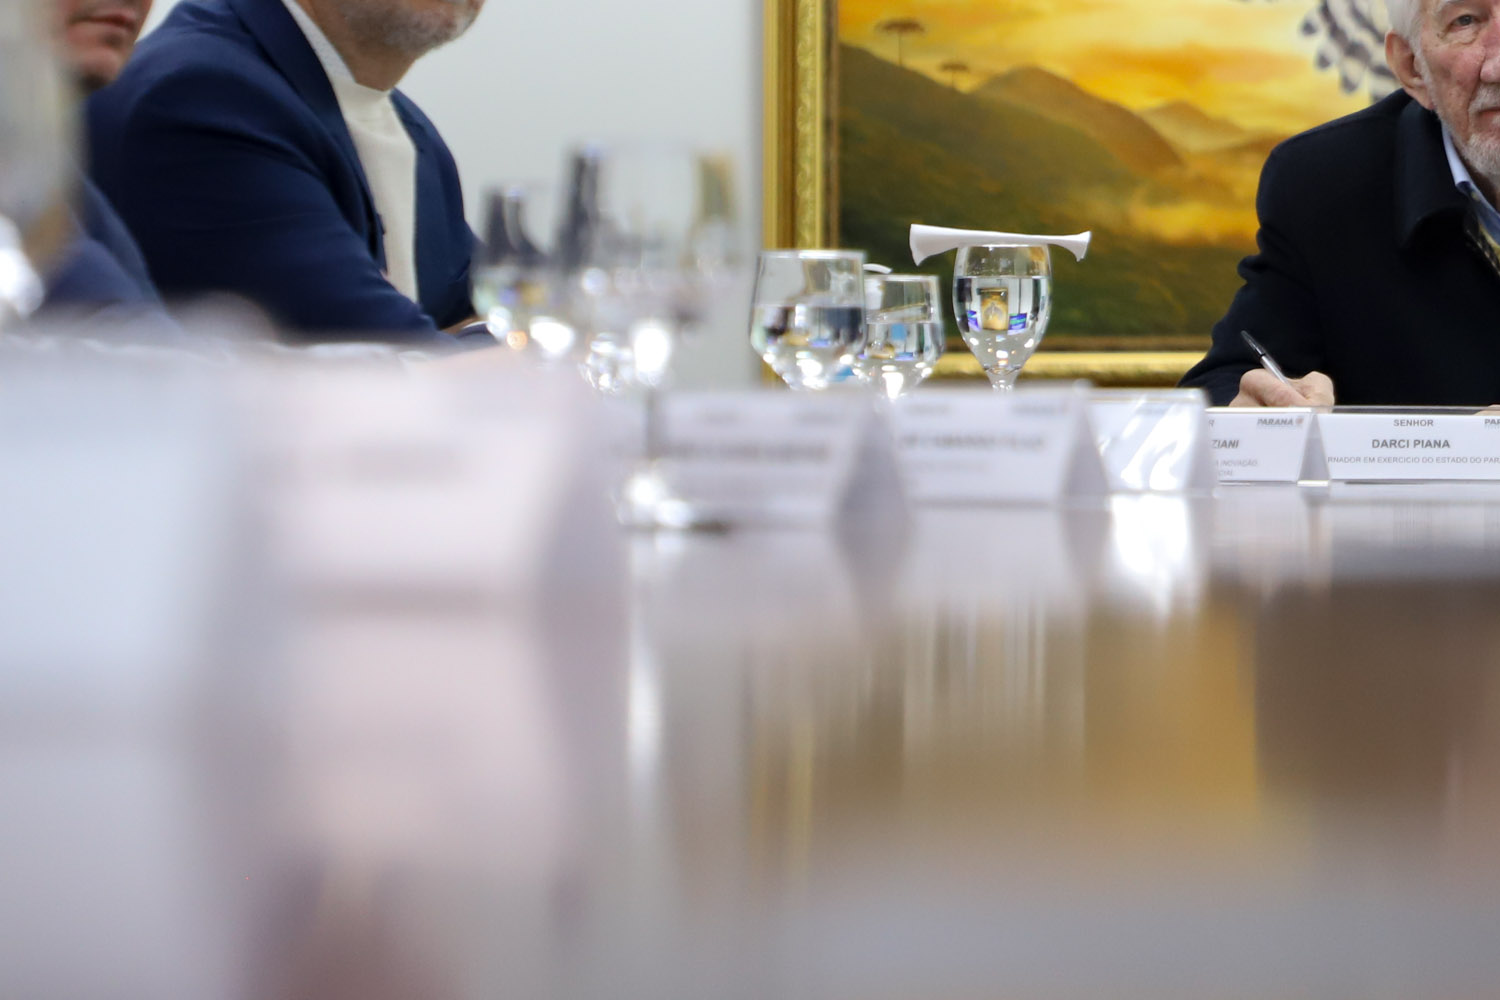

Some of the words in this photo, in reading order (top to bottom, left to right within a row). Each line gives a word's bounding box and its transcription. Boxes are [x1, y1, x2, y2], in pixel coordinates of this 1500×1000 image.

[1393, 419, 1434, 427] SENHOR
[1211, 440, 1240, 449] ZIANI
[1371, 439, 1410, 449] DARCI
[1413, 439, 1451, 449] PIANA
[1327, 456, 1361, 464] RNADOR
[1363, 456, 1376, 464] EM
[1422, 456, 1434, 464] DO
[1436, 456, 1468, 464] ESTADO
[1470, 456, 1482, 464] DO
